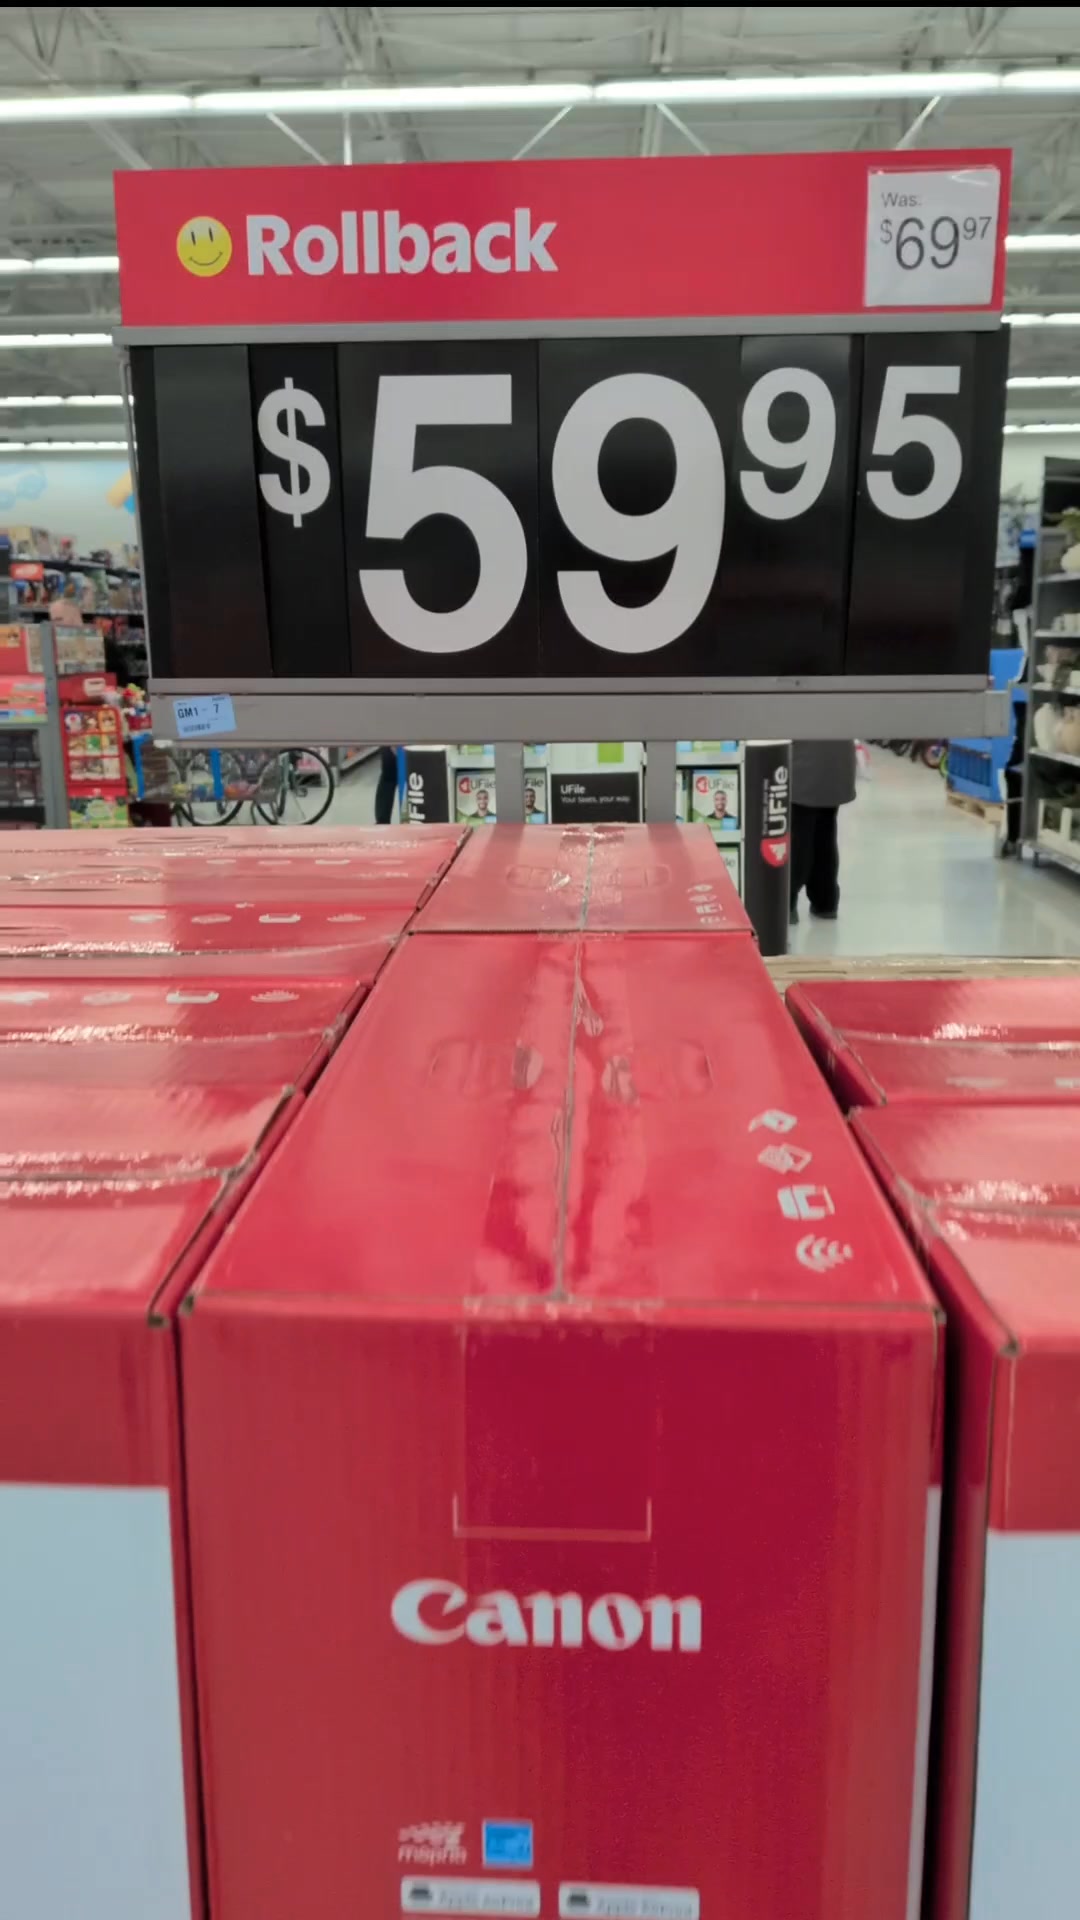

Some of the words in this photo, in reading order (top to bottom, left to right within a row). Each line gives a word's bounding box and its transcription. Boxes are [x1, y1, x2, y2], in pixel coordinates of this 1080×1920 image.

[246, 208, 559, 276] Rollback
[524, 777, 544, 788] File
[560, 783, 586, 795] UFile
[708, 777, 735, 790] UFile
[767, 765, 788, 836] UFile
[391, 1578, 702, 1653] Canon
